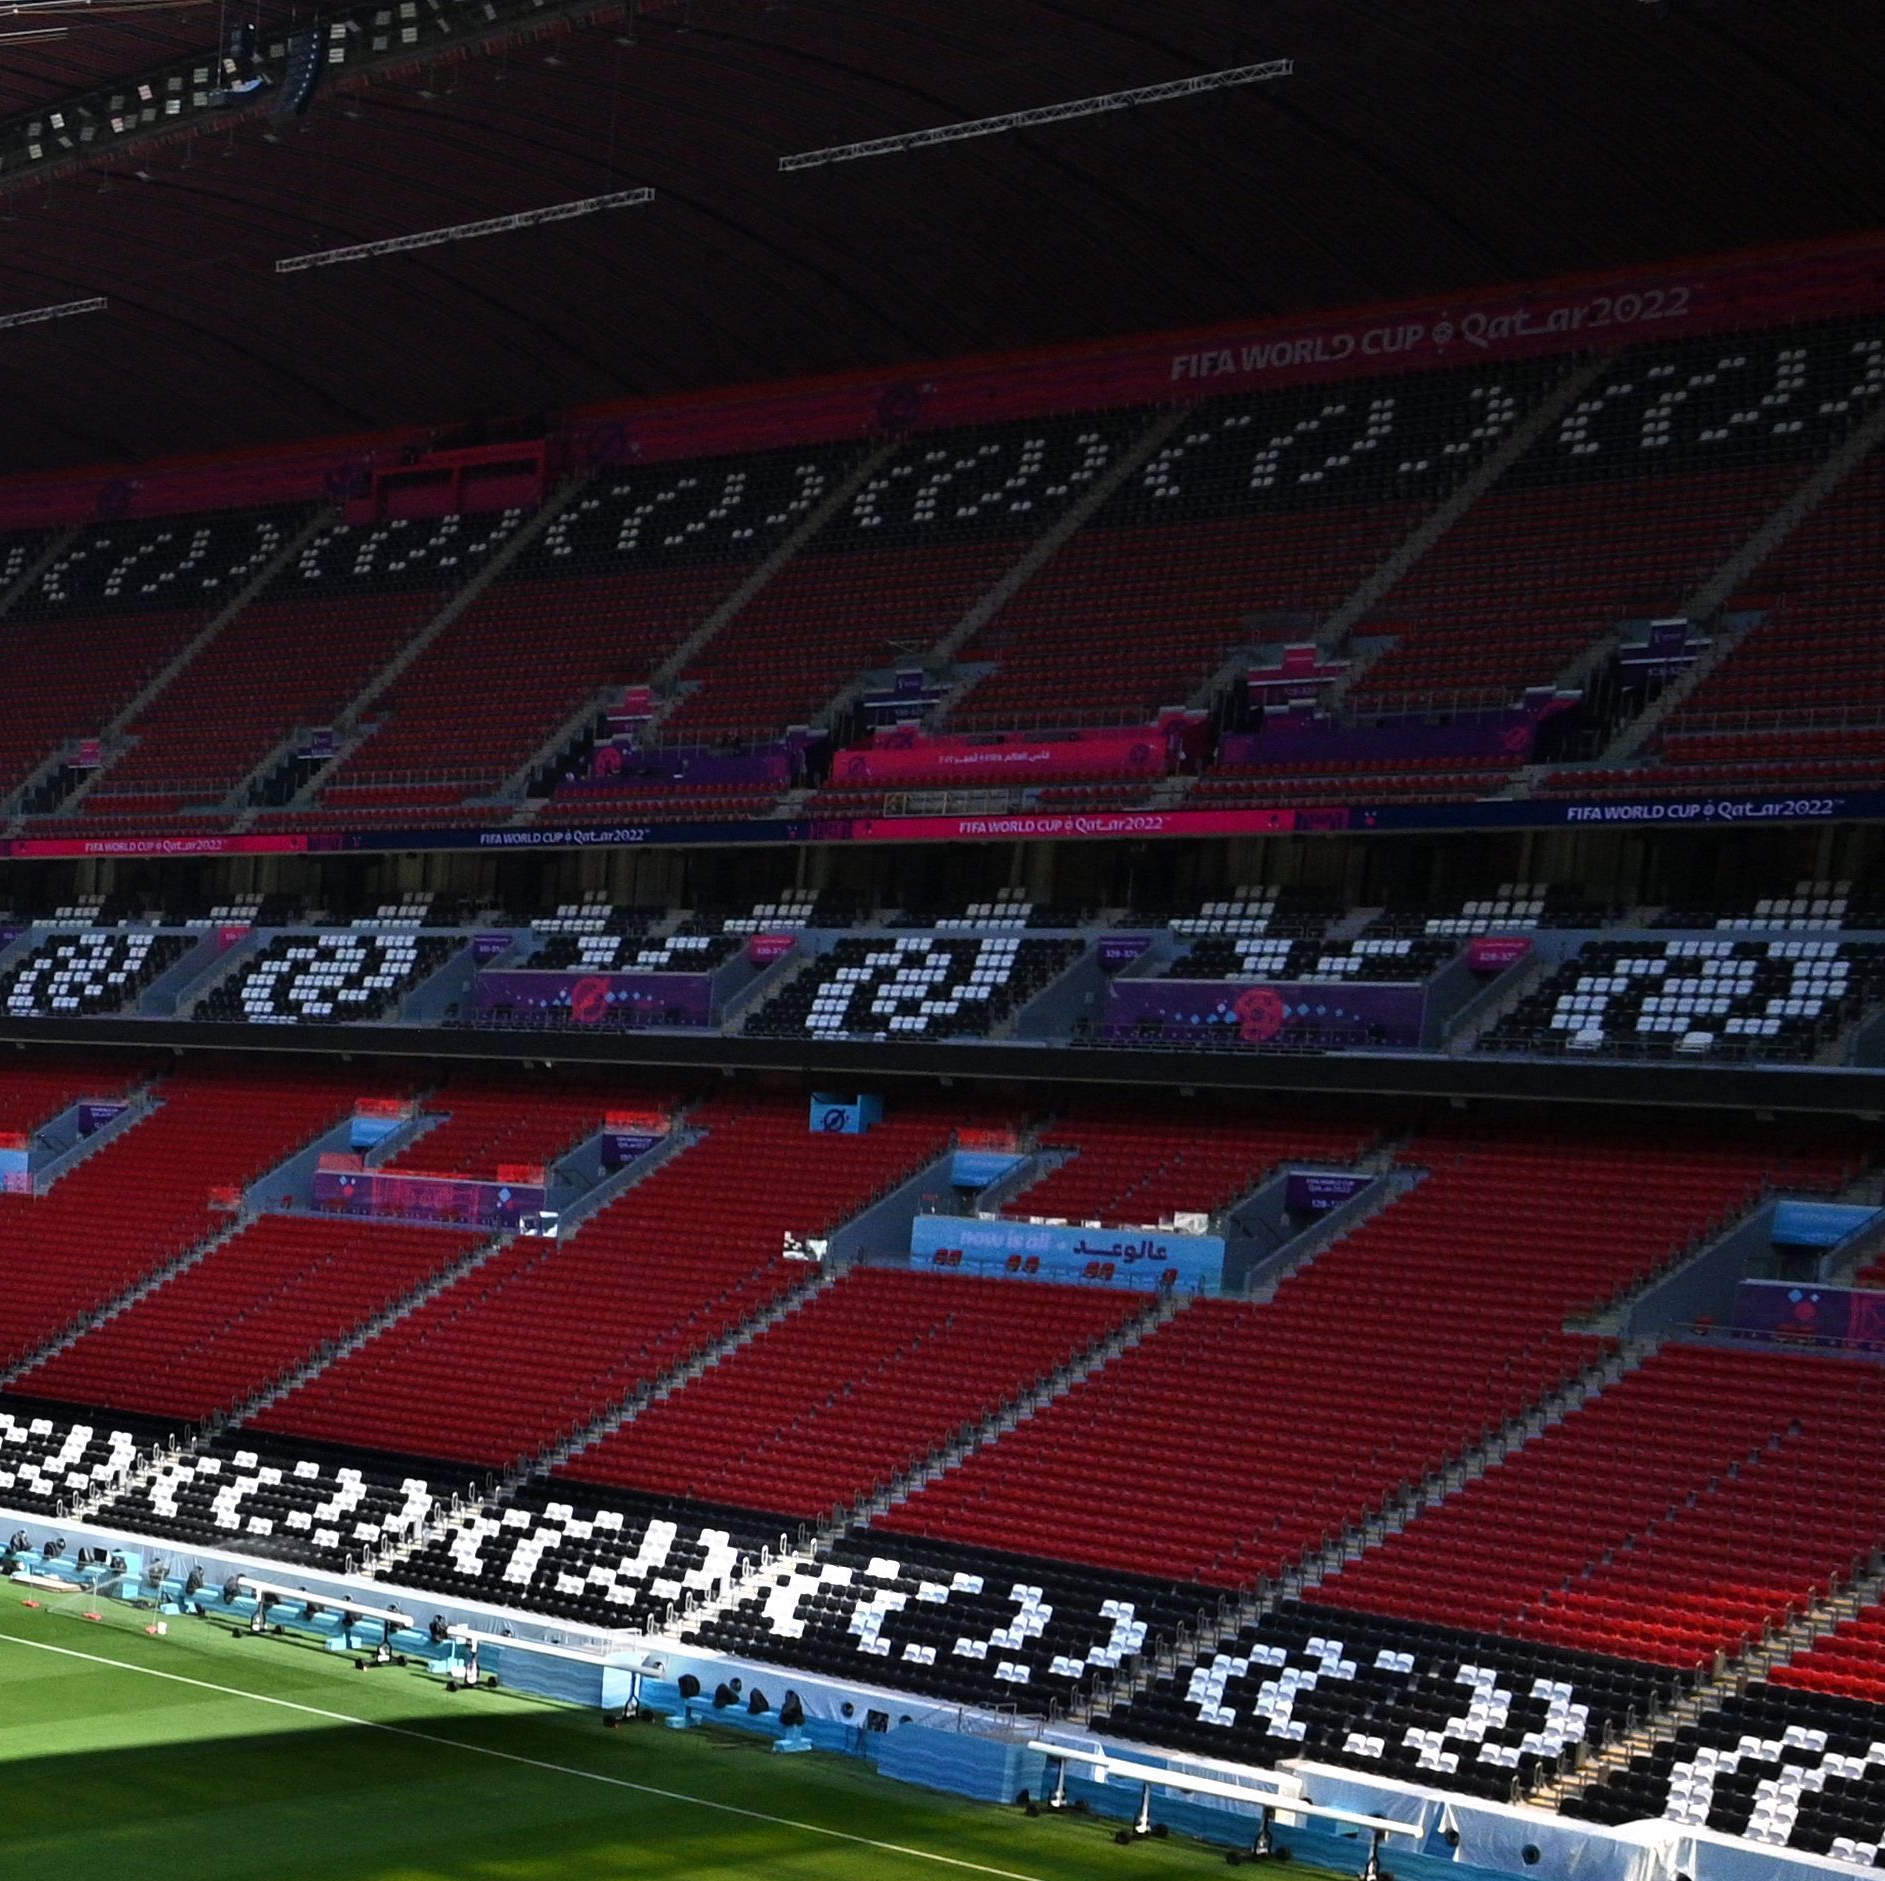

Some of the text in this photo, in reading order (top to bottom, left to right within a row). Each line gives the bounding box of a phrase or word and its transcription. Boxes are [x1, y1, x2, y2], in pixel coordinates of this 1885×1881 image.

[1171, 350, 1237, 381] FIFA
[1241, 333, 1356, 373] WORLD
[1361, 323, 1426, 356] CUP
[1566, 806, 1602, 821] FIFA
[1603, 804, 1665, 821] WORLD
[1667, 803, 1701, 819] CUP
[959, 821, 989, 834] FIFA
[988, 820, 1035, 834] WORLD
[1036, 819, 1063, 833] CUP
[479, 833, 503, 845] FIFA
[502, 832, 541, 844] WORLD
[542, 831, 564, 843] CUP
[85, 843, 106, 853] FIFA
[105, 842, 140, 852] WORLD
[140, 841, 155, 851] CUP
